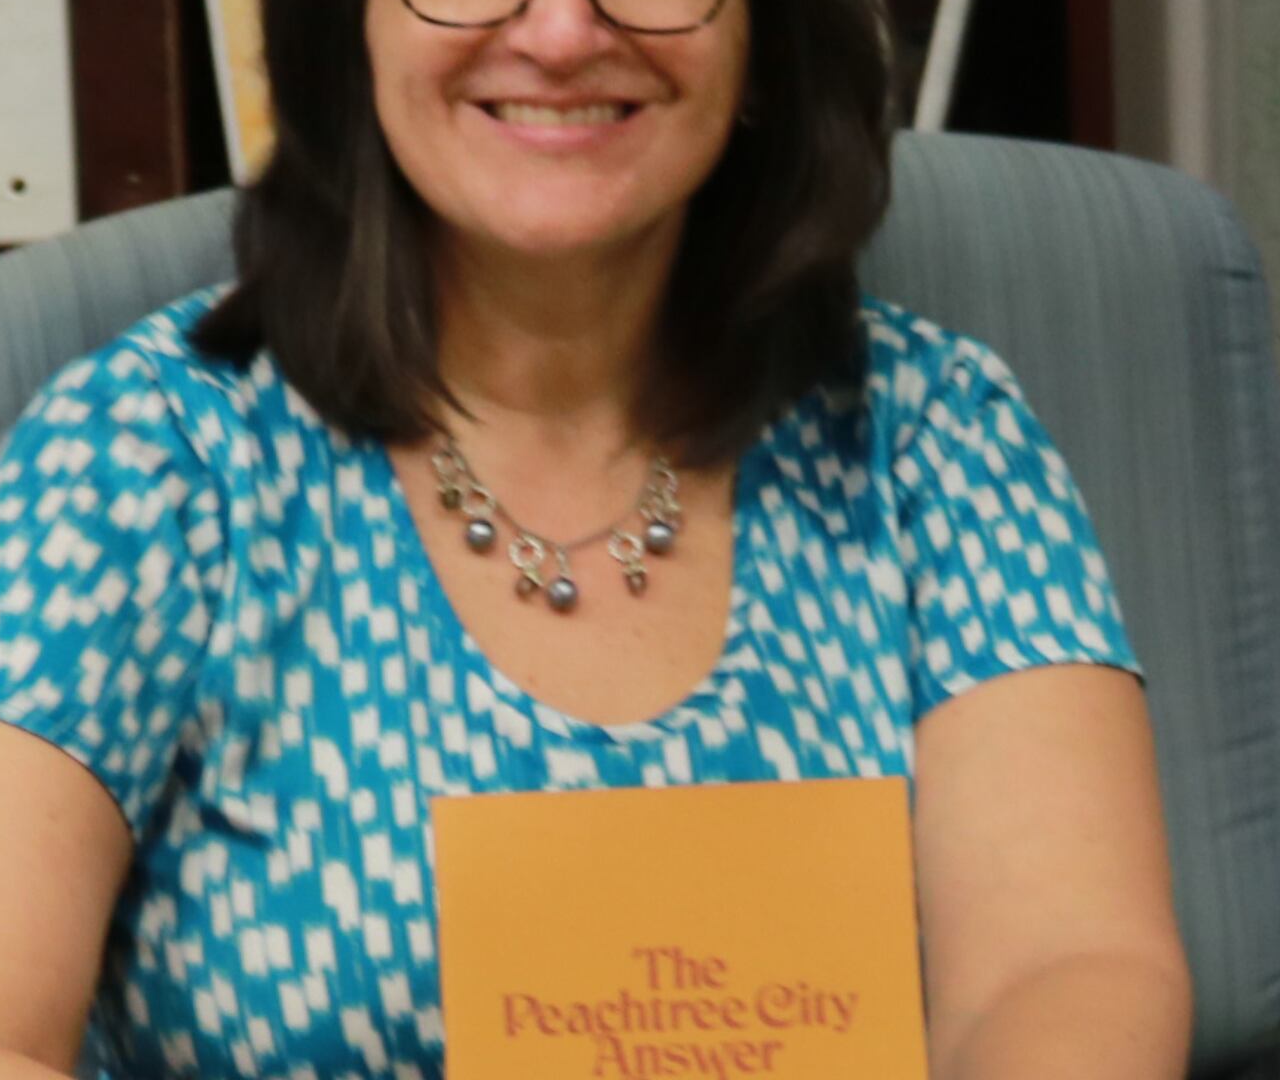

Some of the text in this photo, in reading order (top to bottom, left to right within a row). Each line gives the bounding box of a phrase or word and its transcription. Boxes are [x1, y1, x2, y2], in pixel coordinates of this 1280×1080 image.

[631, 944, 727, 990] The
[502, 981, 859, 1038] Peachtree City
[592, 1035, 784, 1079] Answer
